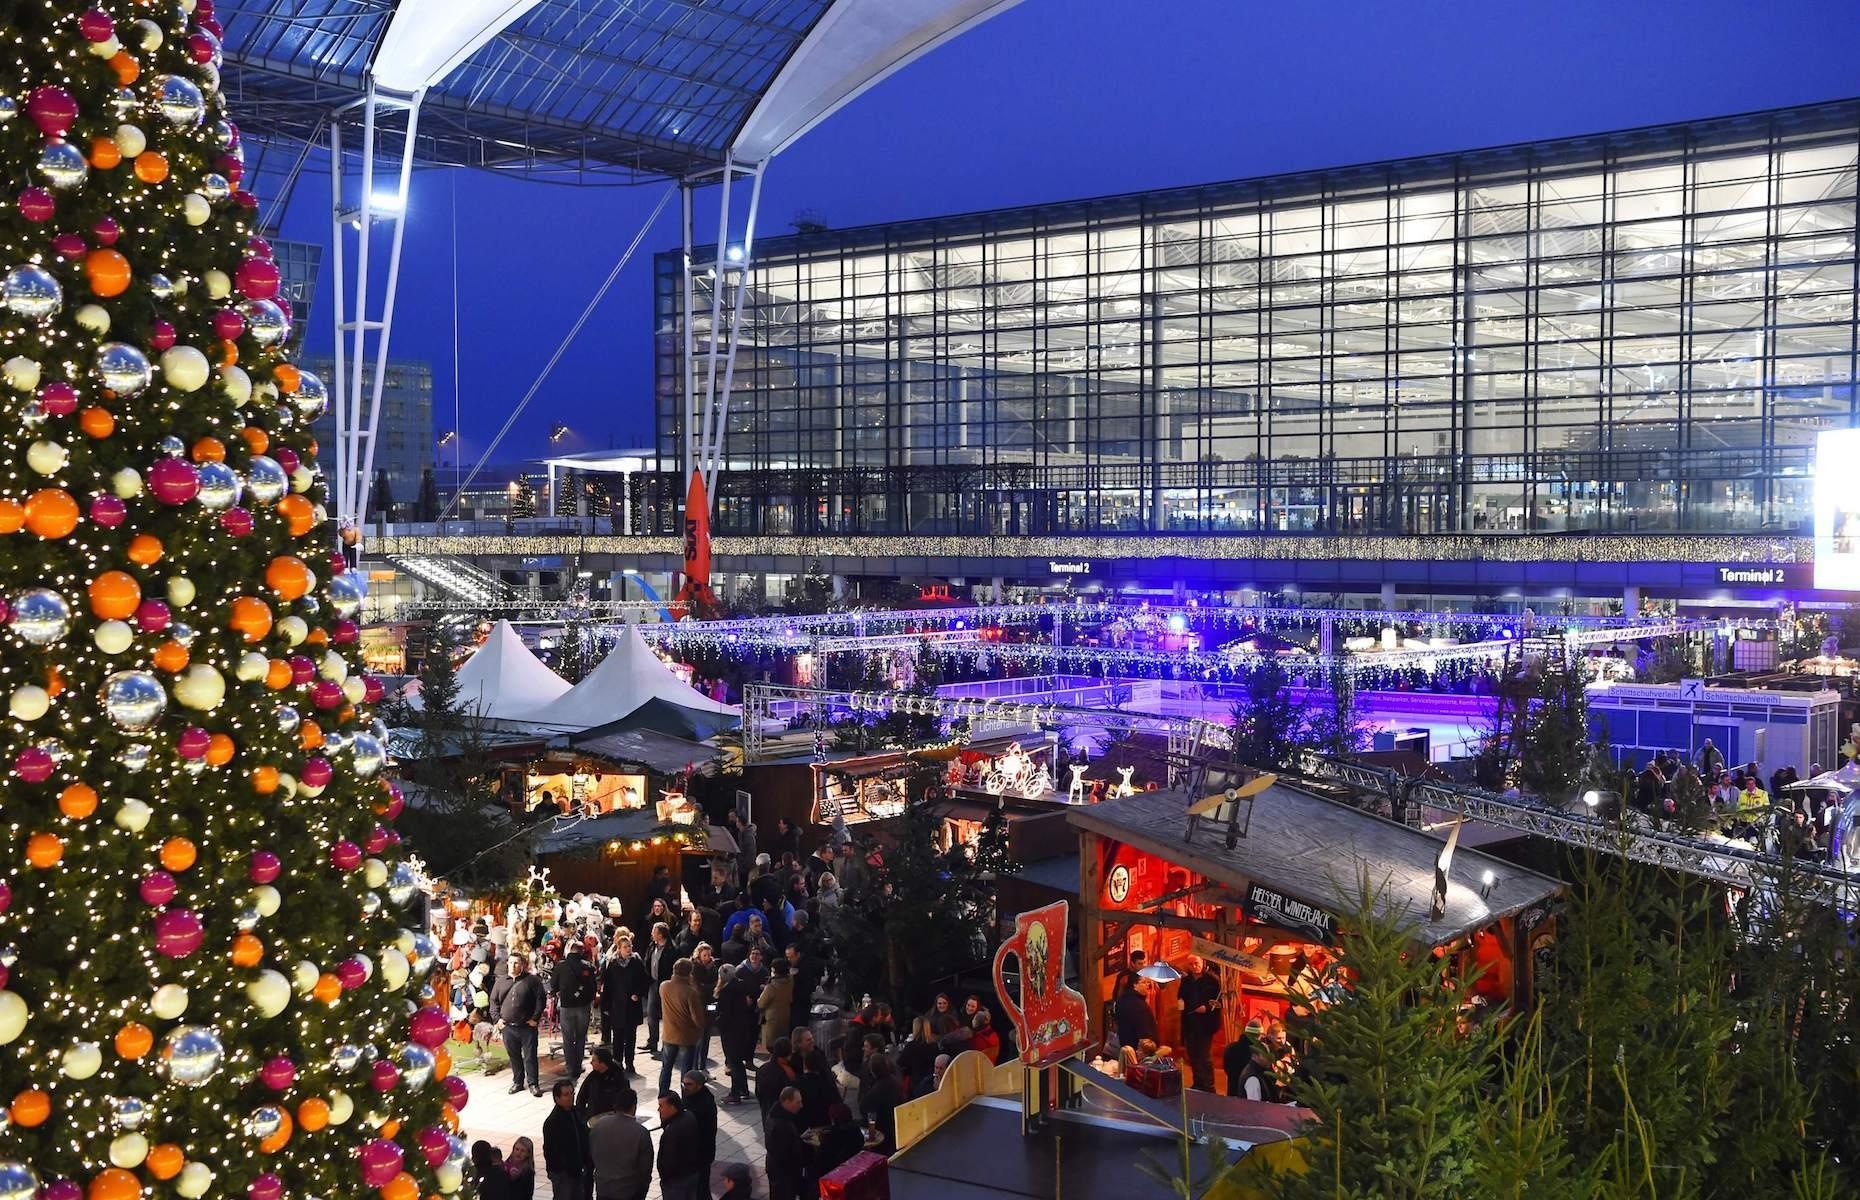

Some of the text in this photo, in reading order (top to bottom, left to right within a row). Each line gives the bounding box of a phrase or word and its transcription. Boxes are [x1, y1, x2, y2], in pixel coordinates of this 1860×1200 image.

[1049, 561, 1090, 573] Terminal 2
[1720, 568, 1785, 582] Terminal 2
[1610, 688, 1679, 699] Schlittschuhverleih
[1705, 692, 1778, 704] Schlittschuhverleih
[1251, 886, 1330, 930] HEISSER WINTER-JACK
